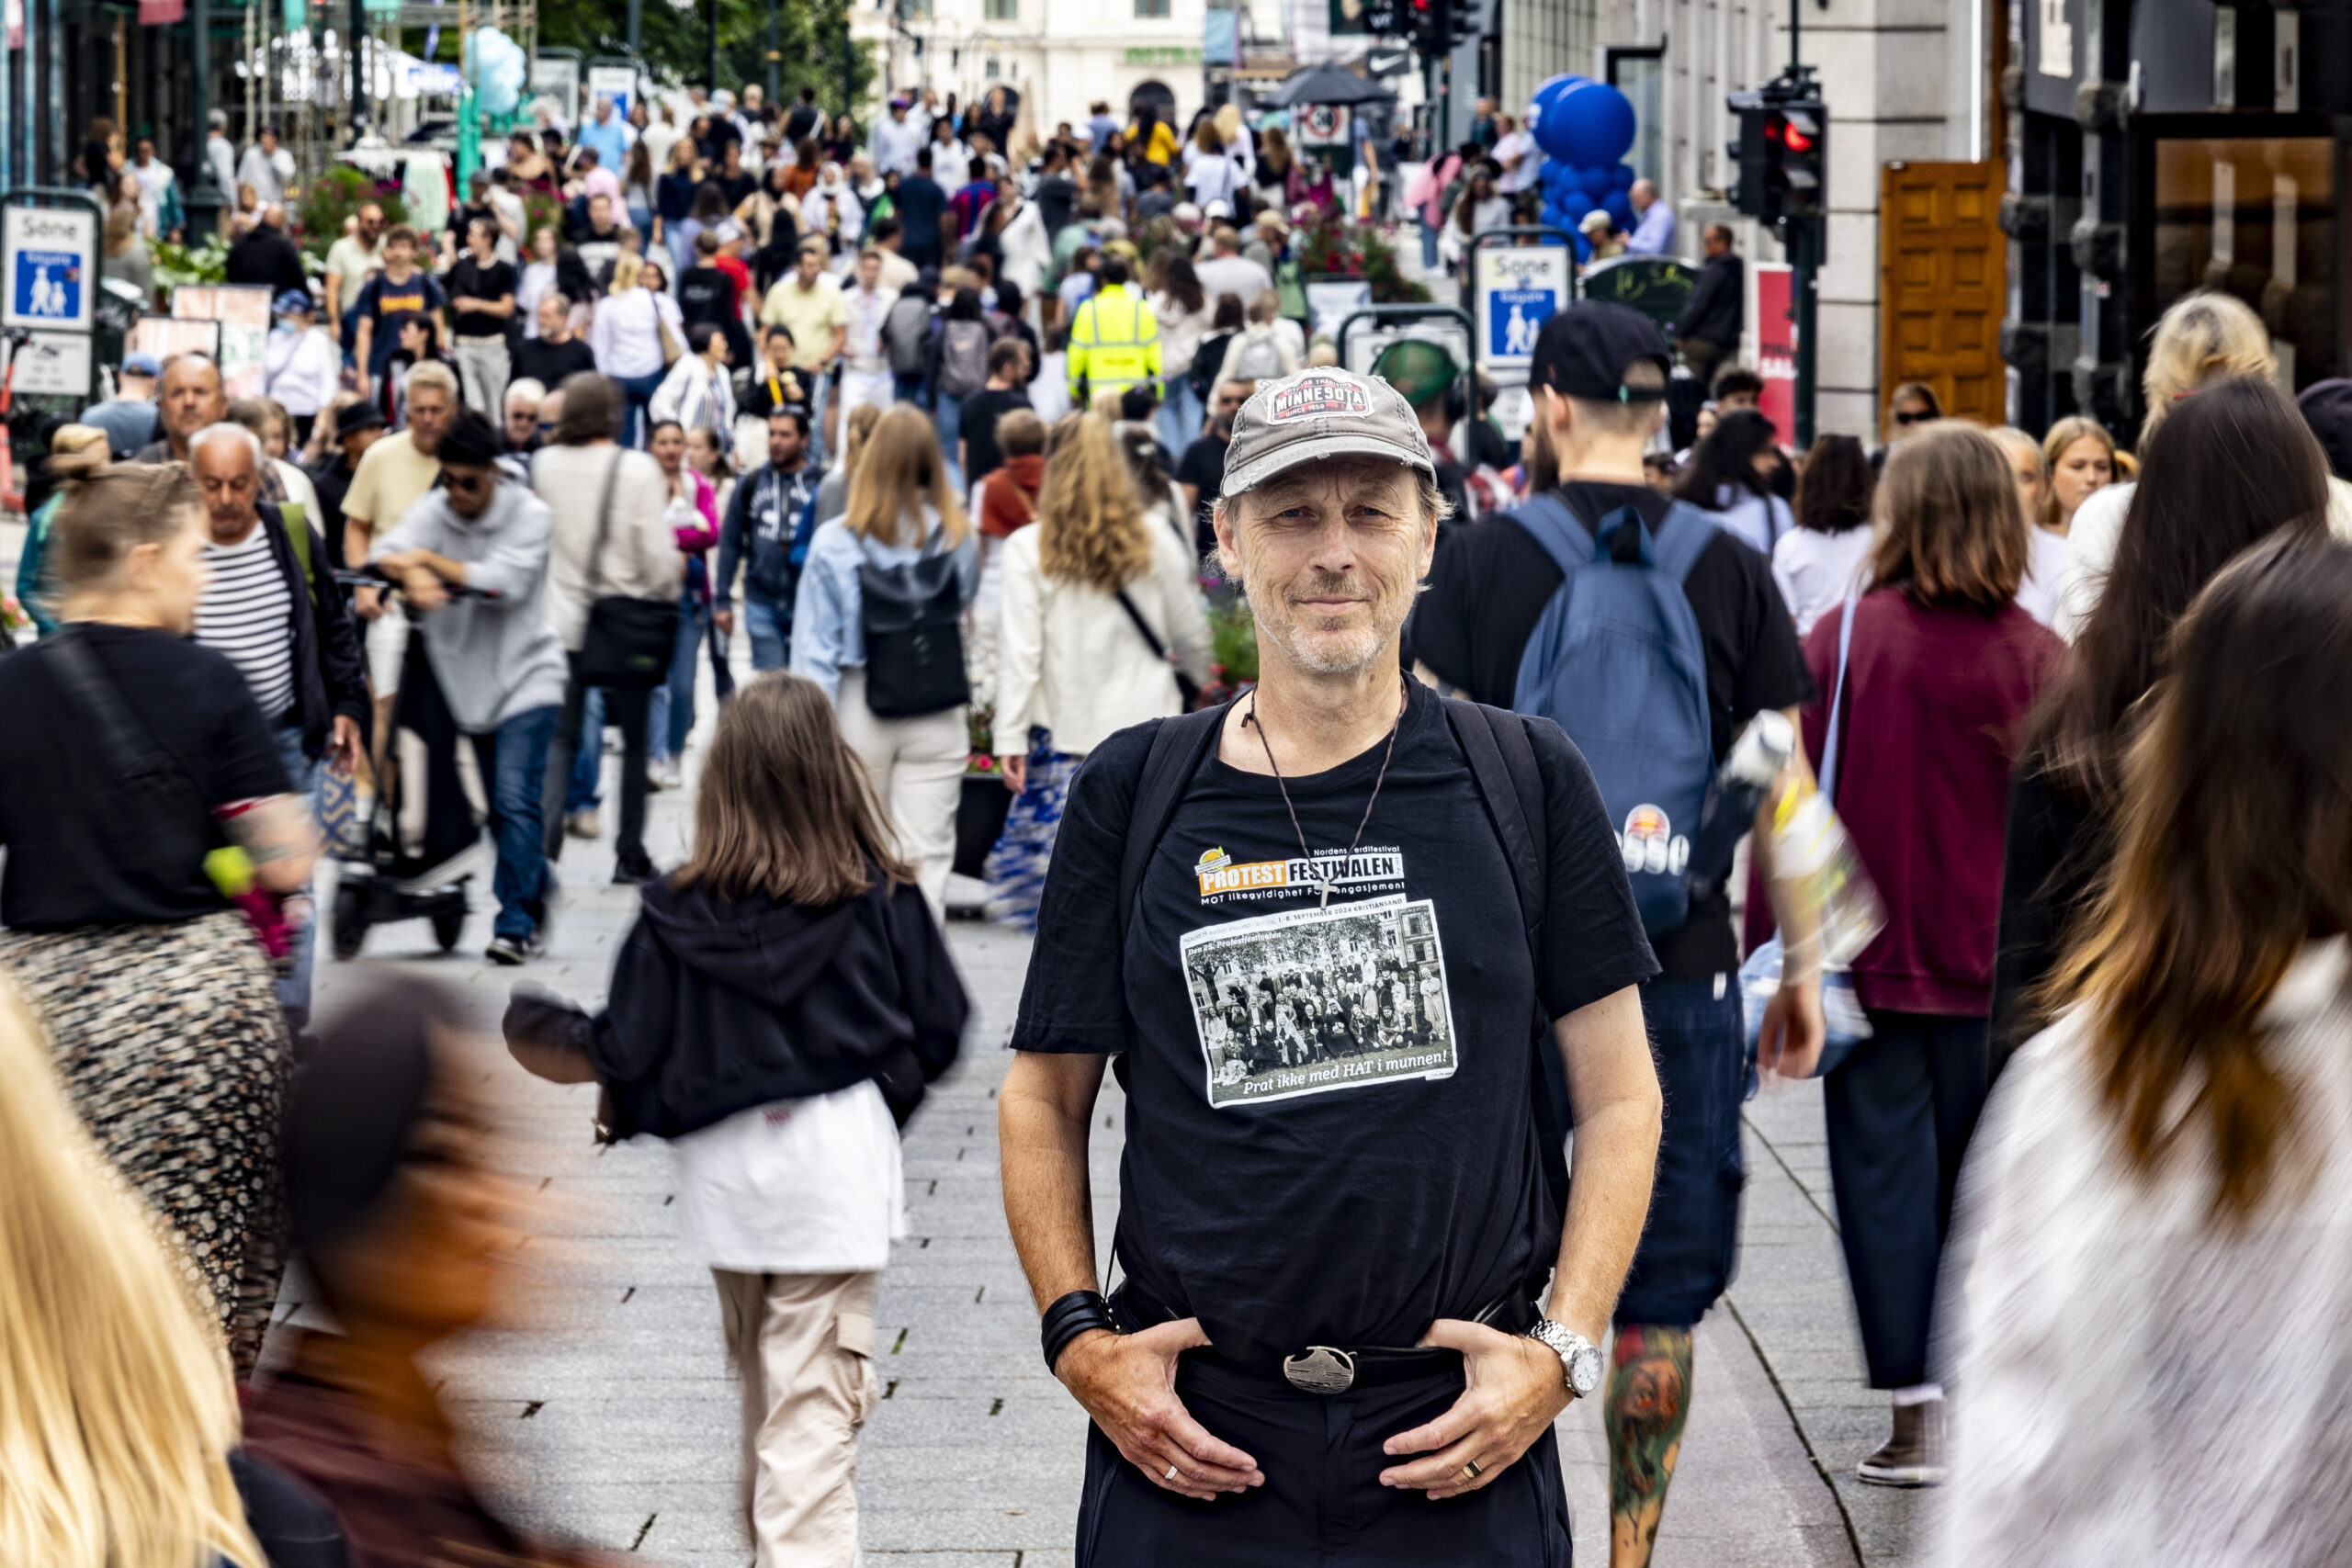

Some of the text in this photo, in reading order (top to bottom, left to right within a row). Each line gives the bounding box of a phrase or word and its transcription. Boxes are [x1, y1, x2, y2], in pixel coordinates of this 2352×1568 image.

[22, 216, 77, 240] Sone
[1495, 254, 1551, 276] Sone
[1275, 386, 1363, 412] MINNESOTA
[1285, 406, 1306, 418] SINCE
[1313, 845, 1400, 857] Nordens erdifestival
[1202, 863, 1284, 892] PROTEST
[1289, 857, 1395, 883] FESTIVALEN
[1201, 895, 1225, 906] MOT
[1228, 888, 1303, 902] likegyldighet
[1294, 909, 1332, 921] SEPTEMBER
[1334, 907, 1352, 916] 2024
[1353, 898, 1403, 912] KRISTIANSAND
[1243, 1050, 1448, 1095] Prat ikke med HAT i munnen!
